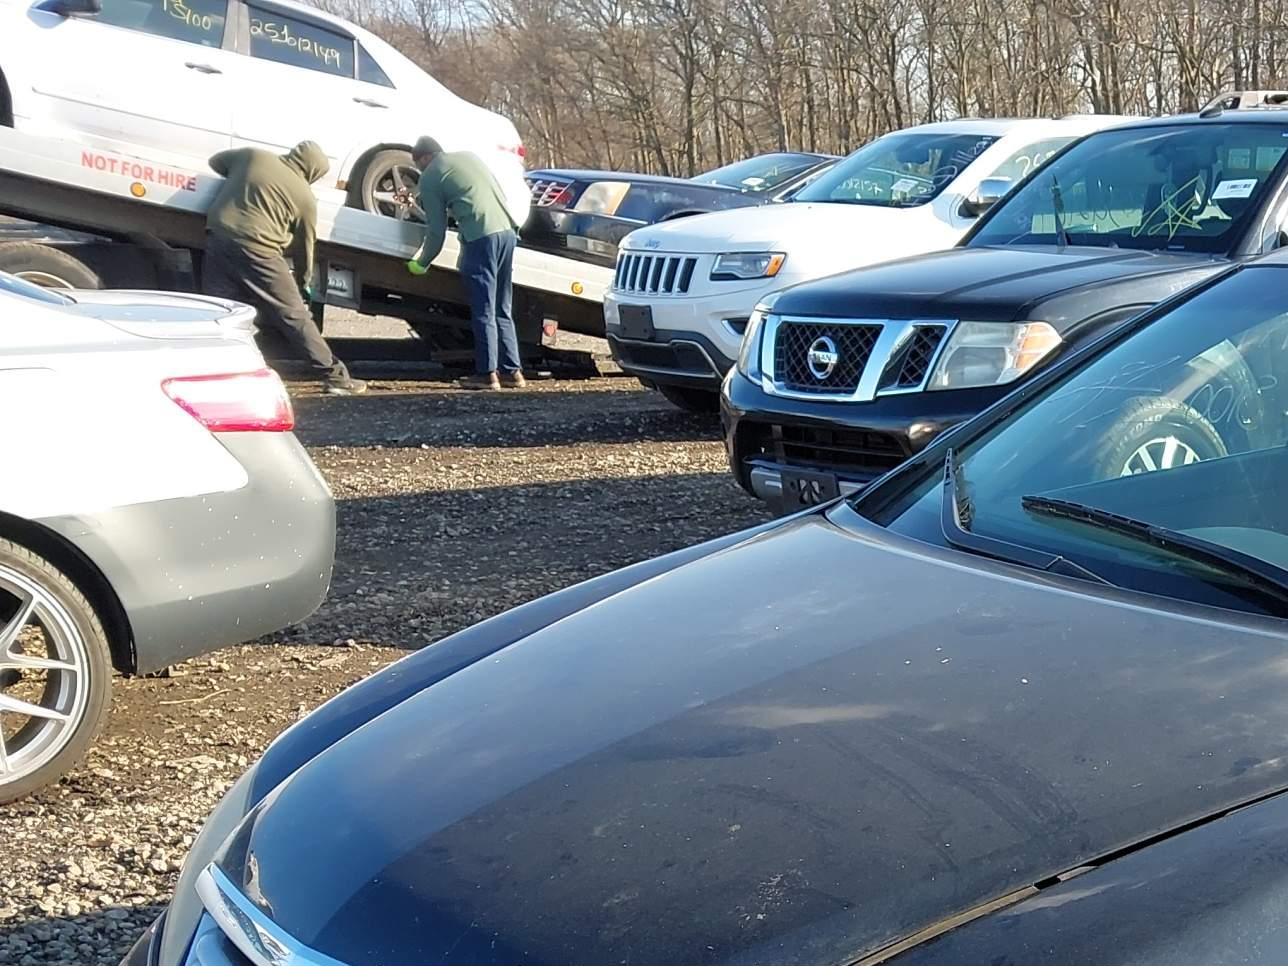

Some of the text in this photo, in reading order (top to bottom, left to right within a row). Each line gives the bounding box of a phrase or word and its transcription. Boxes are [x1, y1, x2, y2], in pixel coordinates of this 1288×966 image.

[81, 151, 197, 192] NOT FOR HIRE
